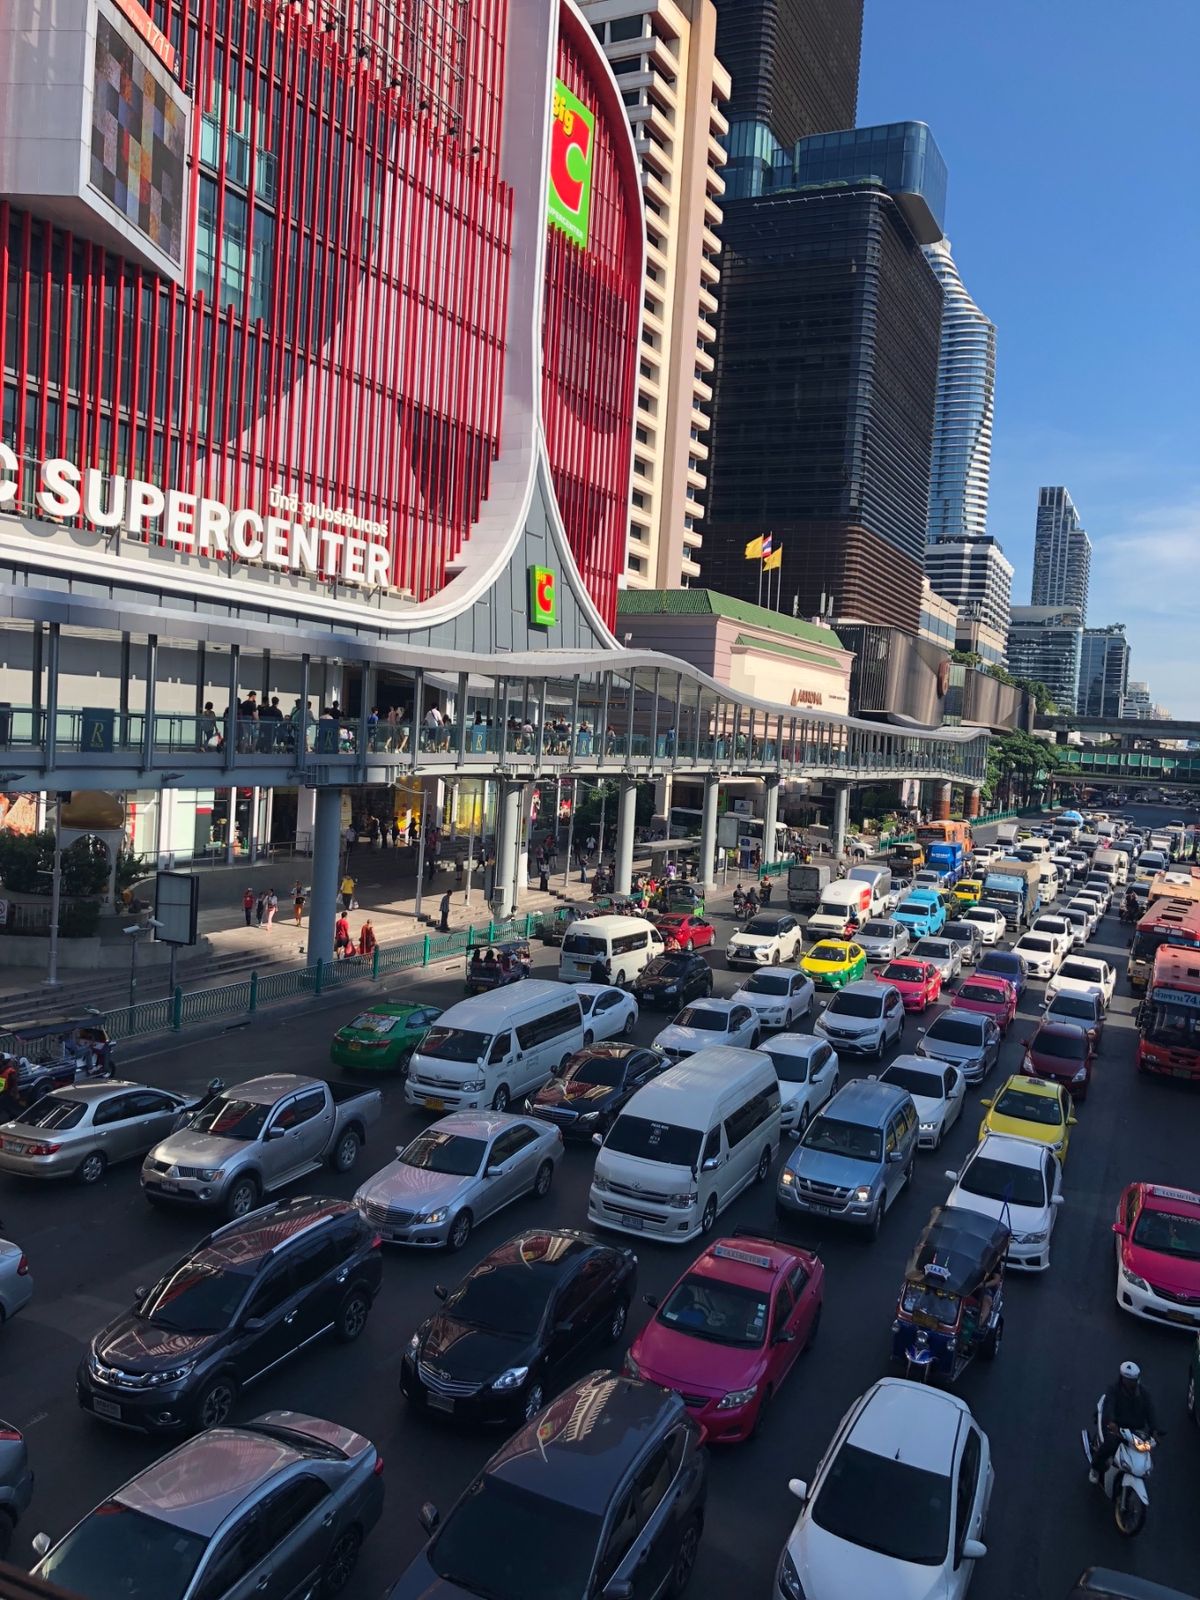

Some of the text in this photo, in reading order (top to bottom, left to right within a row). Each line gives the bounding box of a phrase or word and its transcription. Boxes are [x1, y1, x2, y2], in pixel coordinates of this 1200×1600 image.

[550, 109, 591, 215] C
[36, 458, 390, 587] SUPERCENTER
[1183, 994, 1197, 1005] 74
